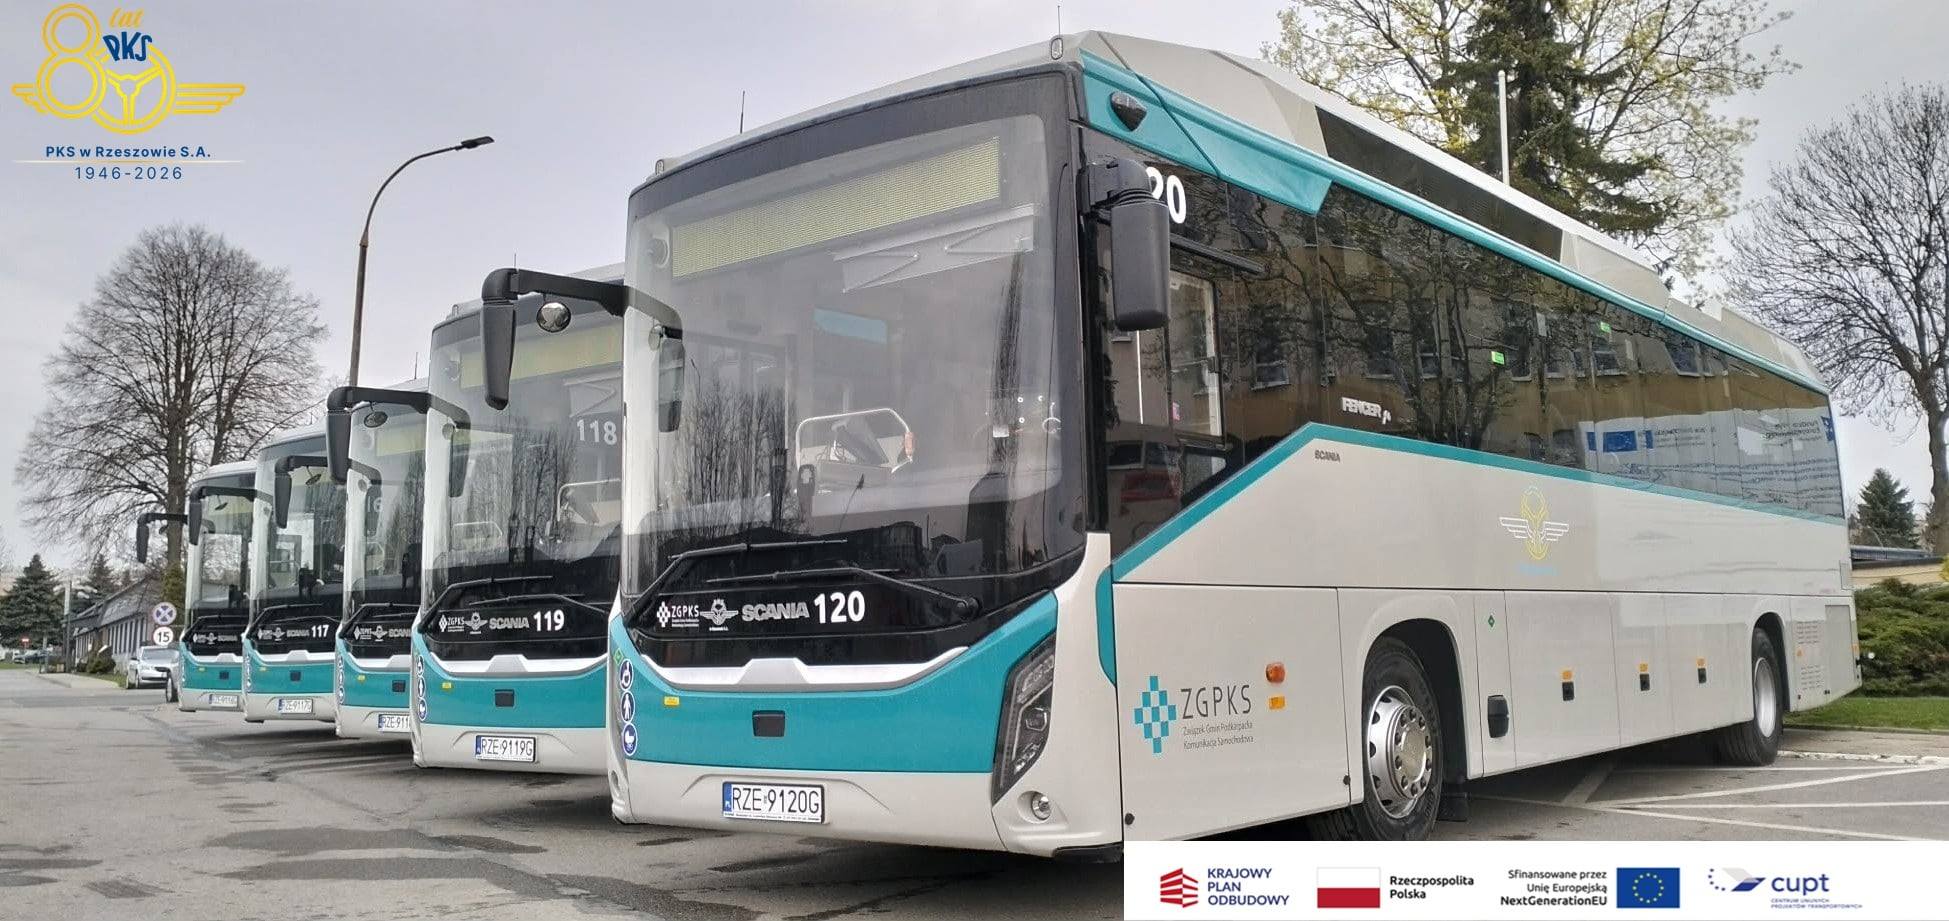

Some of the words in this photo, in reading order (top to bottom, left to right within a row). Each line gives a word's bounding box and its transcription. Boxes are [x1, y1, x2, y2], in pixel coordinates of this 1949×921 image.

[1341, 397, 1382, 419] FENCER
[576, 419, 618, 446] 118
[1314, 450, 1341, 463] SCANIA
[671, 604, 700, 618] ZGPKS
[742, 601, 810, 622] SCANIA
[814, 590, 866, 624] 120
[311, 624, 330, 638] 117
[489, 616, 530, 630] SCANIA
[533, 609, 565, 632] 119
[157, 631, 171, 644] 15
[1180, 684, 1252, 720] ZGPKS
[481, 738, 499, 755] RZE
[501, 739, 533, 757] 9119G
[732, 787, 762, 811] RZE
[767, 788, 820, 814] 9120G
